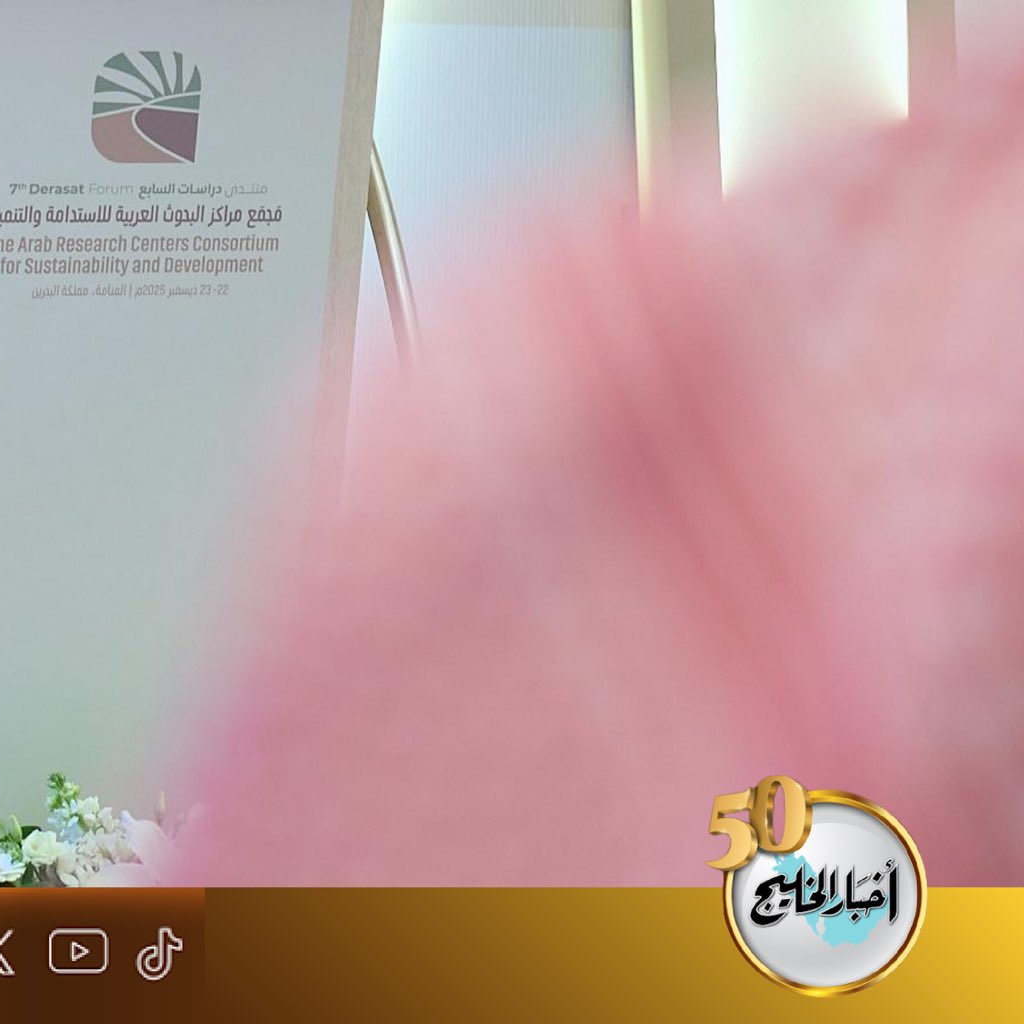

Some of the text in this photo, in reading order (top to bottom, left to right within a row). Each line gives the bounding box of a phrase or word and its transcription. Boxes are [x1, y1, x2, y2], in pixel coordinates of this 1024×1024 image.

[9, 183, 134, 196] 7th Derasat Forum
[138, 182, 176, 200] السابع
[178, 182, 222, 198] دراسات
[46, 204, 113, 224] للاستدامة
[115, 205, 160, 228] العربية
[163, 204, 205, 228] البحوث
[208, 205, 242, 228] مراكز
[18, 236, 52, 253] Arab
[56, 235, 127, 253] Research
[131, 235, 189, 253] Centers
[193, 234, 280, 253] Consortium
[1, 255, 263, 277] for Sustainability and Development
[31, 284, 59, 300] البحرين
